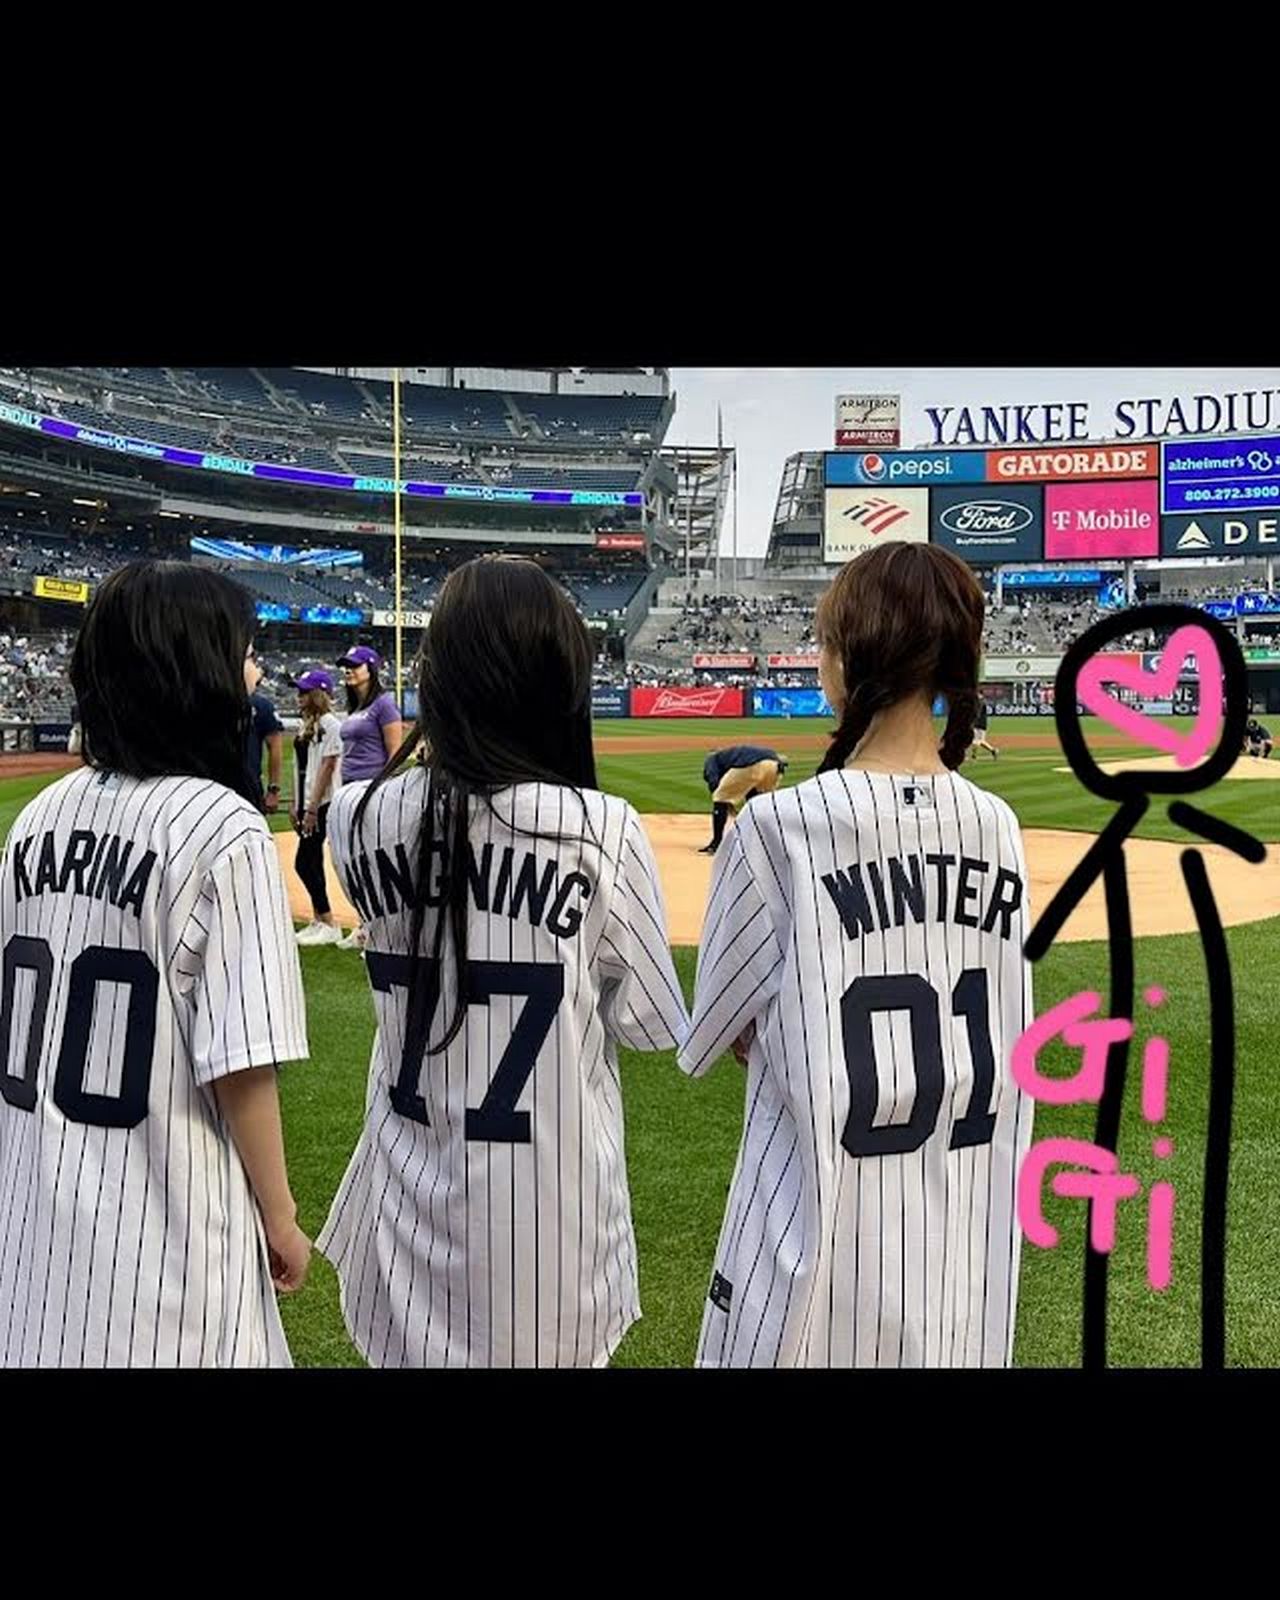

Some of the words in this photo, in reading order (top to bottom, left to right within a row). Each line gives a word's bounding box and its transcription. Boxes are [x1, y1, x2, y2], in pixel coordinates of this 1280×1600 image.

[839, 399, 897, 409] ARMITRON
[925, 402, 1090, 444] YANKEE
[1114, 389, 1280, 438] STADIU
[842, 430, 896, 439] ARMITRON
[890, 457, 948, 479] pepsi
[998, 450, 1148, 476] GATORADE
[1168, 456, 1245, 472] alzheimer's
[1185, 486, 1279, 502] 800.272.3900
[956, 506, 1016, 529] Ford
[1076, 508, 1152, 530] Mobile
[827, 544, 856, 552] BANK
[13, 830, 158, 920] KARINA
[821, 854, 1023, 940] WINTER
[0, 934, 160, 1128] 00
[365, 950, 565, 1143] 77
[840, 968, 997, 1158] 01
